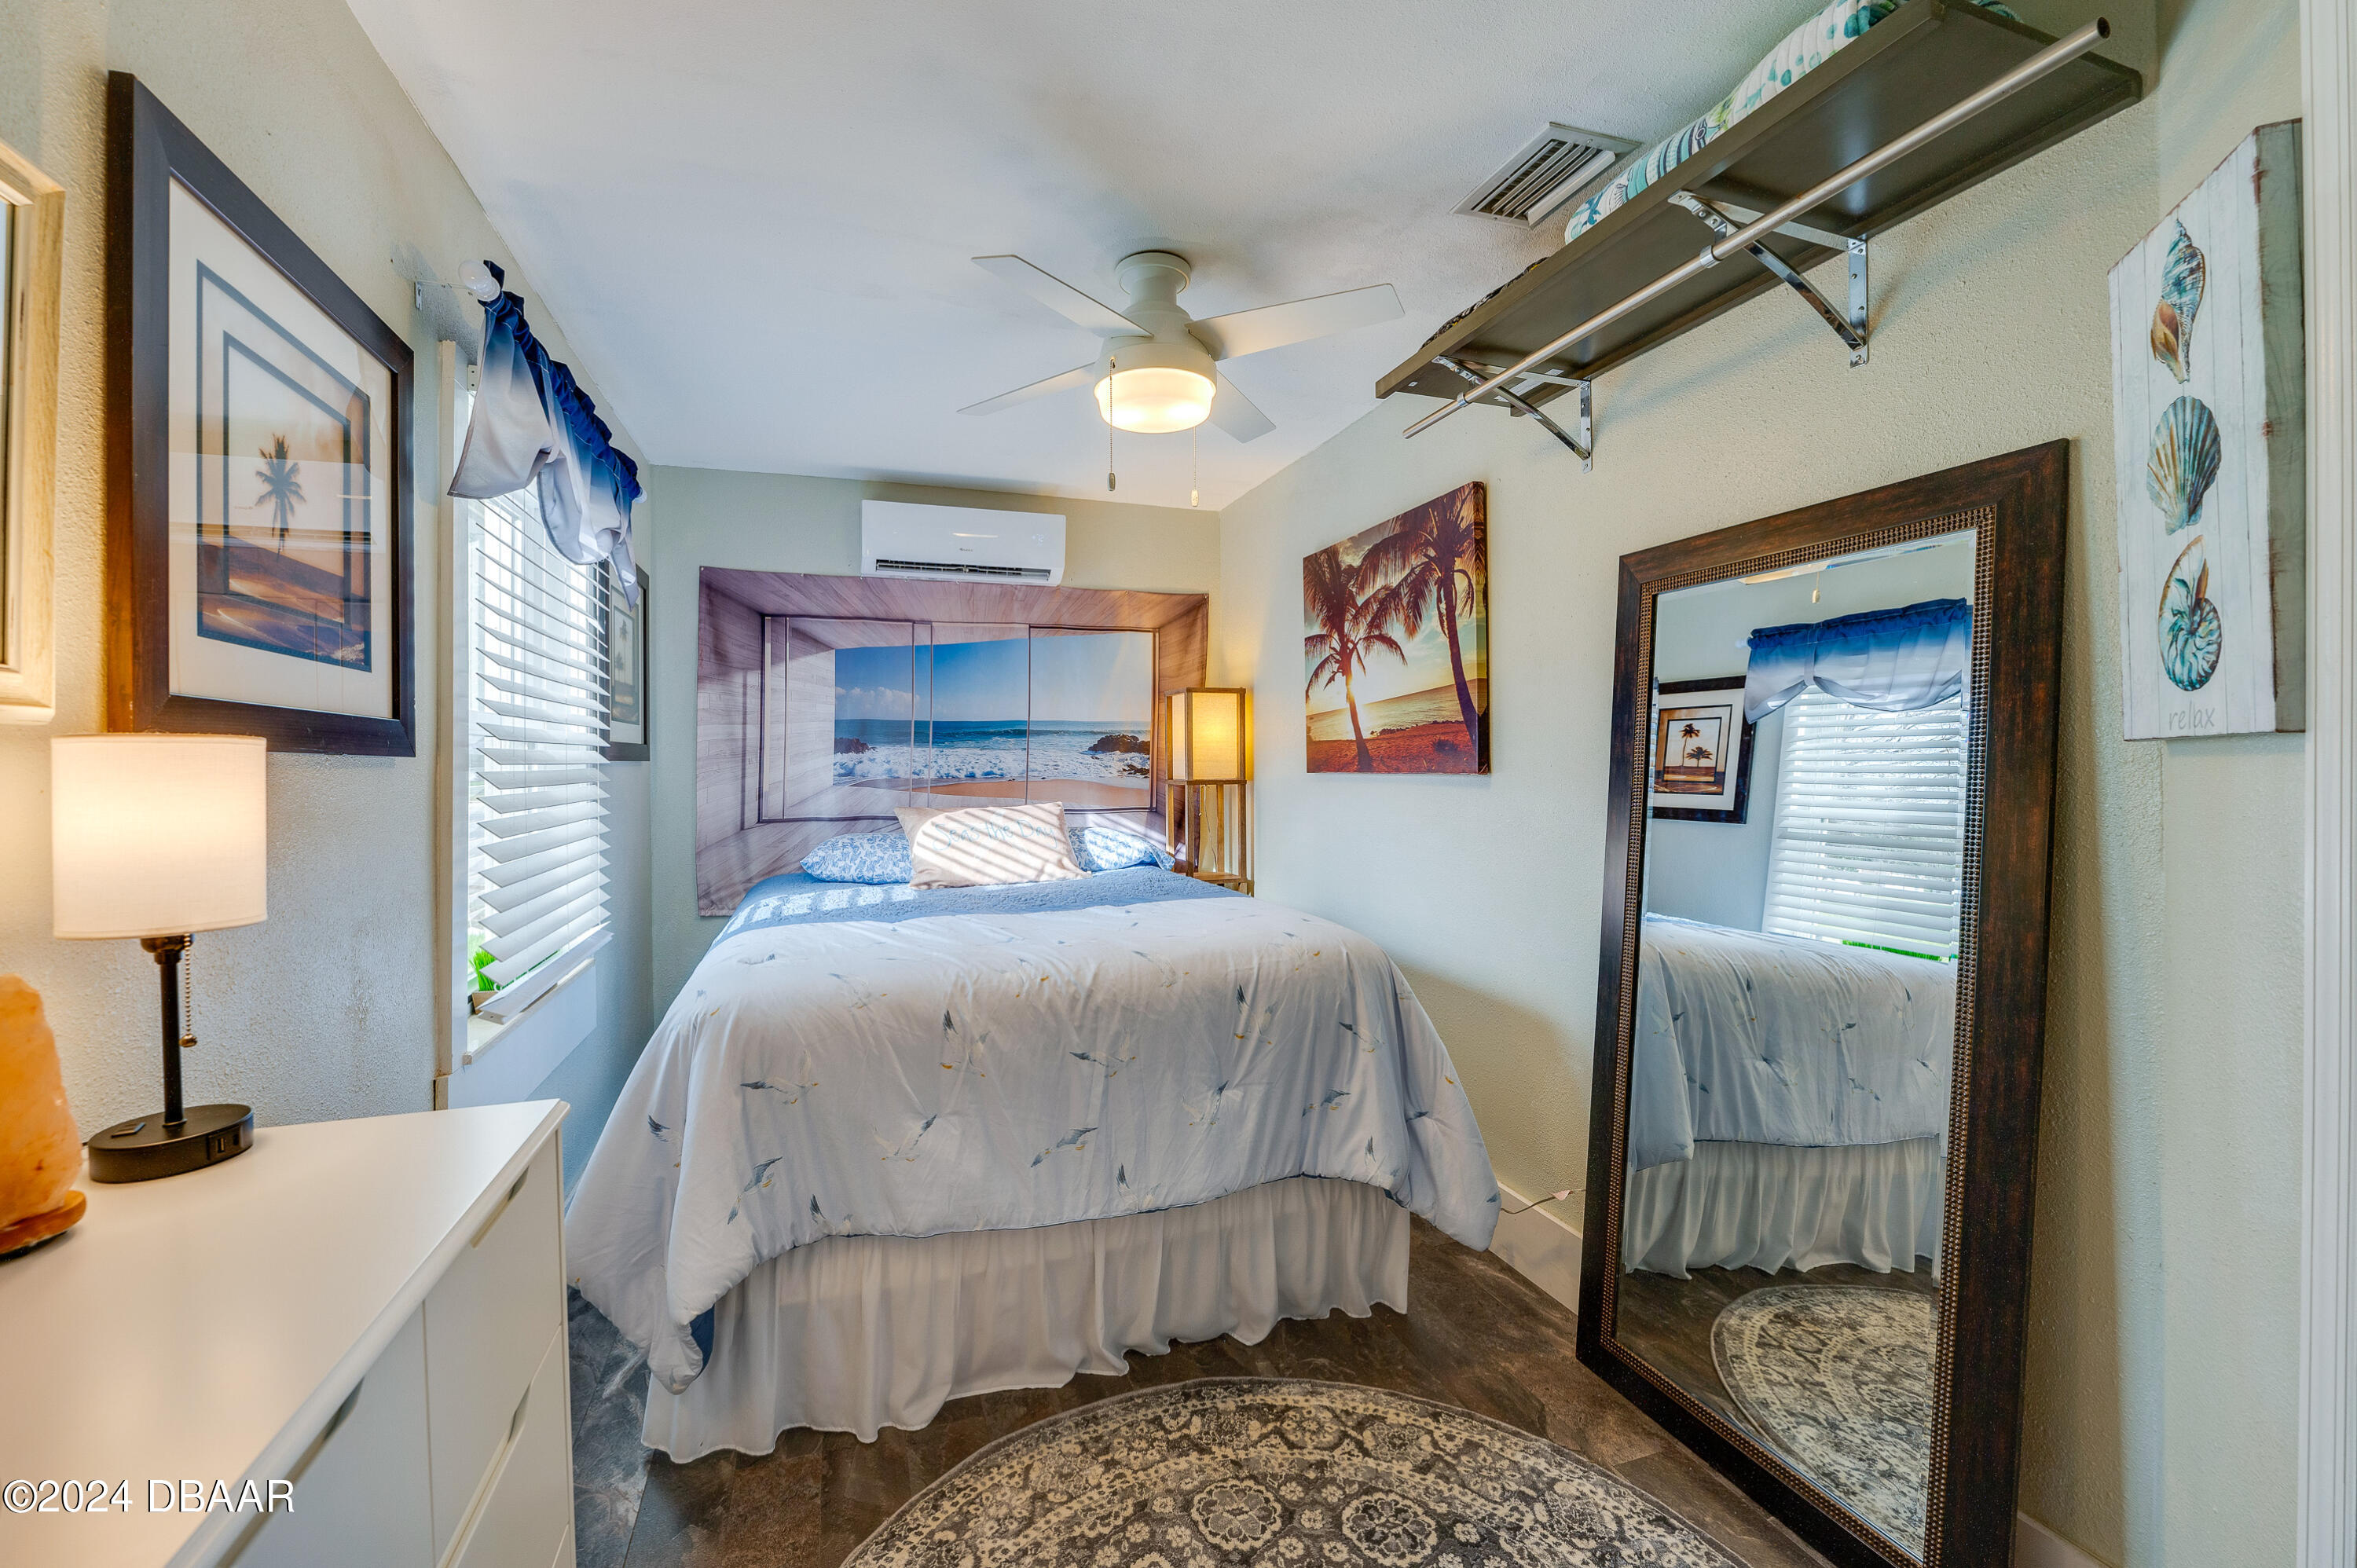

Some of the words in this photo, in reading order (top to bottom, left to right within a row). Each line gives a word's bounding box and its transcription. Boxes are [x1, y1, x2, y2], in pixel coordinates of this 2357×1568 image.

[2168, 700, 2216, 731] relax
[933, 823, 980, 851] Seas
[985, 820, 1014, 841] the
[1016, 819, 1058, 849] Day
